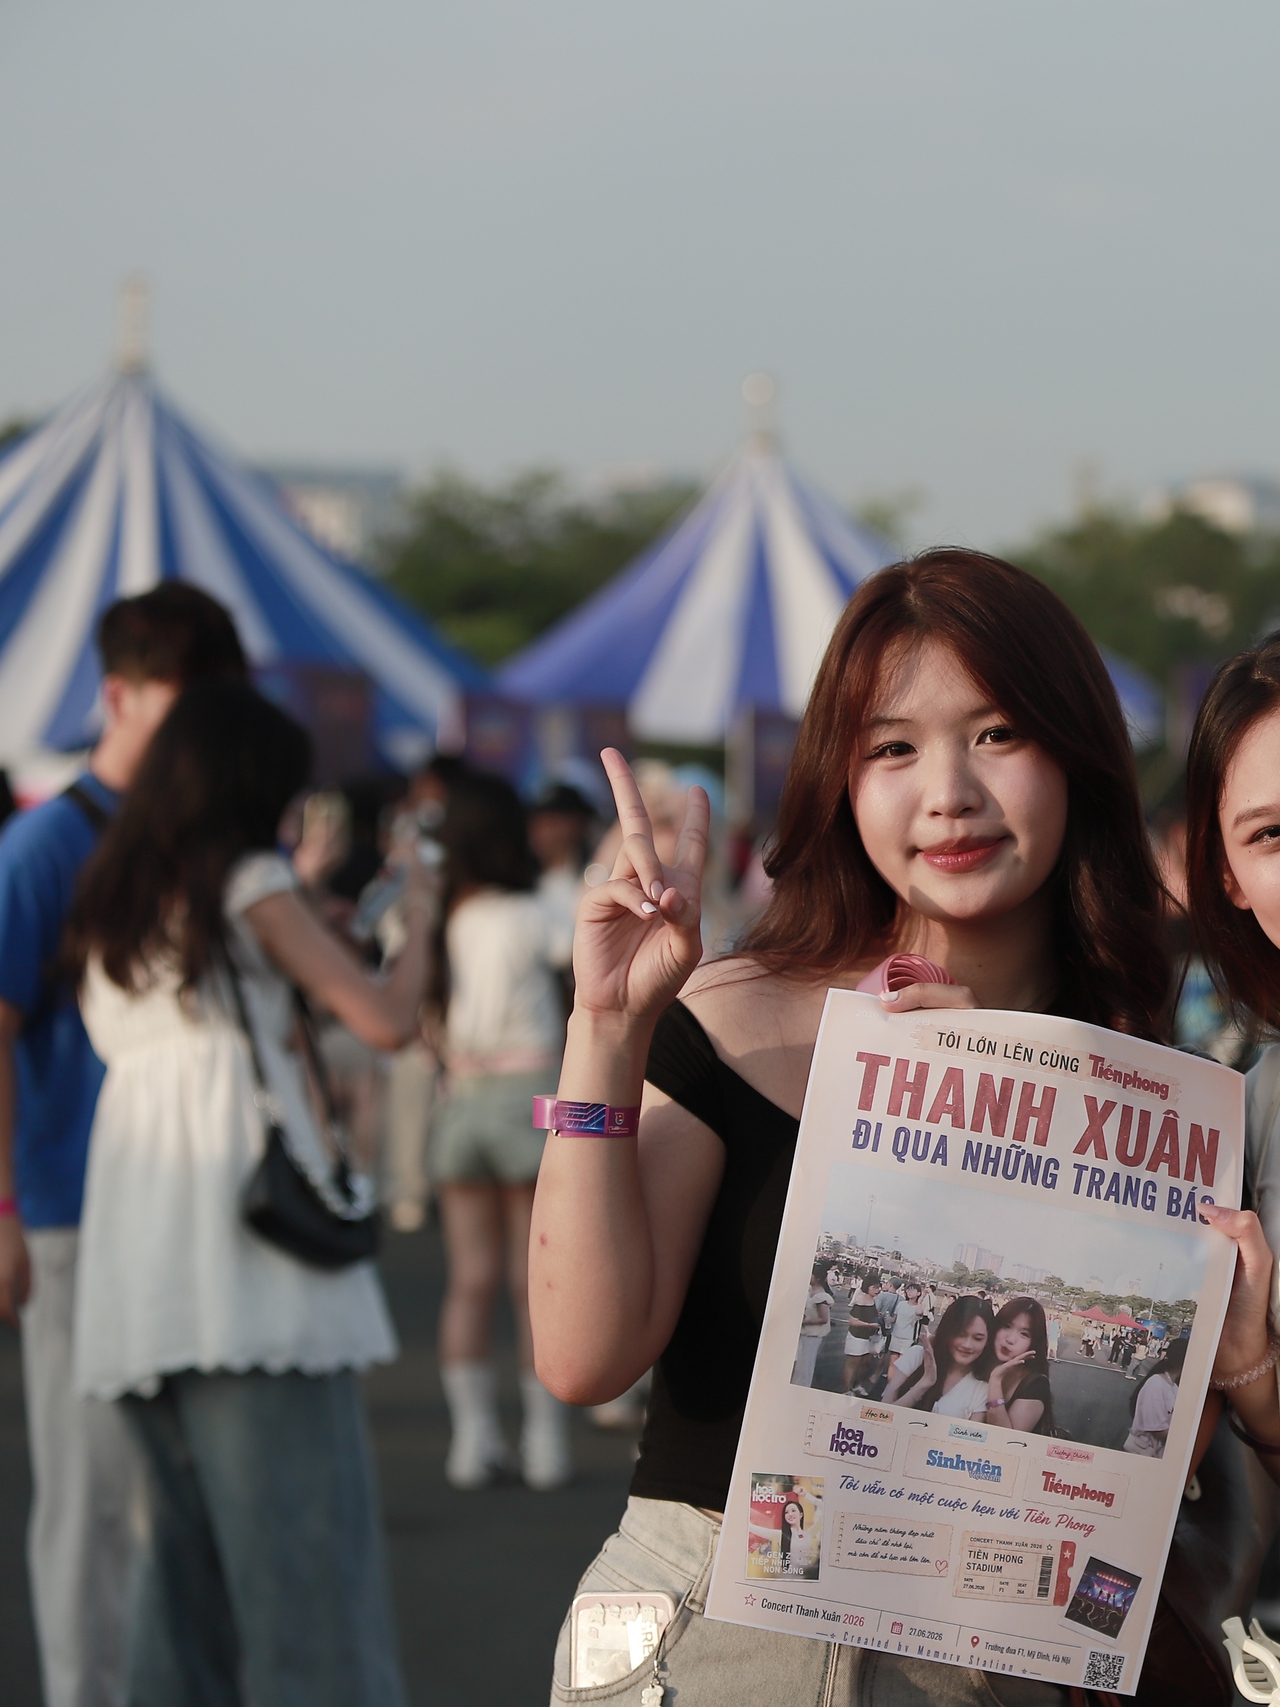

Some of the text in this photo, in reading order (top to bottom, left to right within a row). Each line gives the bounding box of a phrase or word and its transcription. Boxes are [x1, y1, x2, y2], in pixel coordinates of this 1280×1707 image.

[937, 1031, 961, 1049] TÔI
[967, 1037, 997, 1055] LỚN
[1003, 1043, 1034, 1063] LÊN
[1039, 1050, 1080, 1073] CÙNG
[855, 1051, 1220, 1188] THANH XUÂN
[852, 1118, 883, 1153] ĐI
[891, 1126, 948, 1167] QUA
[961, 1140, 1060, 1190] NHỮNG
[1072, 1163, 1157, 1212] TRANG
[836, 1422, 864, 1442] hoa
[756, 1482, 775, 1494] hoa
[839, 1475, 1097, 1538] Tôi vẫn có một cuộc hẹn với Tiền Phong
[969, 1536, 993, 1544] CONCERT
[767, 1551, 791, 1560] GEN Z
[993, 1553, 1024, 1564] PHONG
[763, 1566, 780, 1574] NON
[966, 1562, 1003, 1574] STADIUM
[761, 1598, 793, 1614] Concert
[796, 1604, 819, 1619] Thanh
[821, 1609, 841, 1623] Xuân
[842, 1613, 865, 1627] 2026
[909, 1627, 943, 1641] 27.06.2026
[843, 1631, 890, 1649] Created
[968, 1655, 1014, 1672] Station
